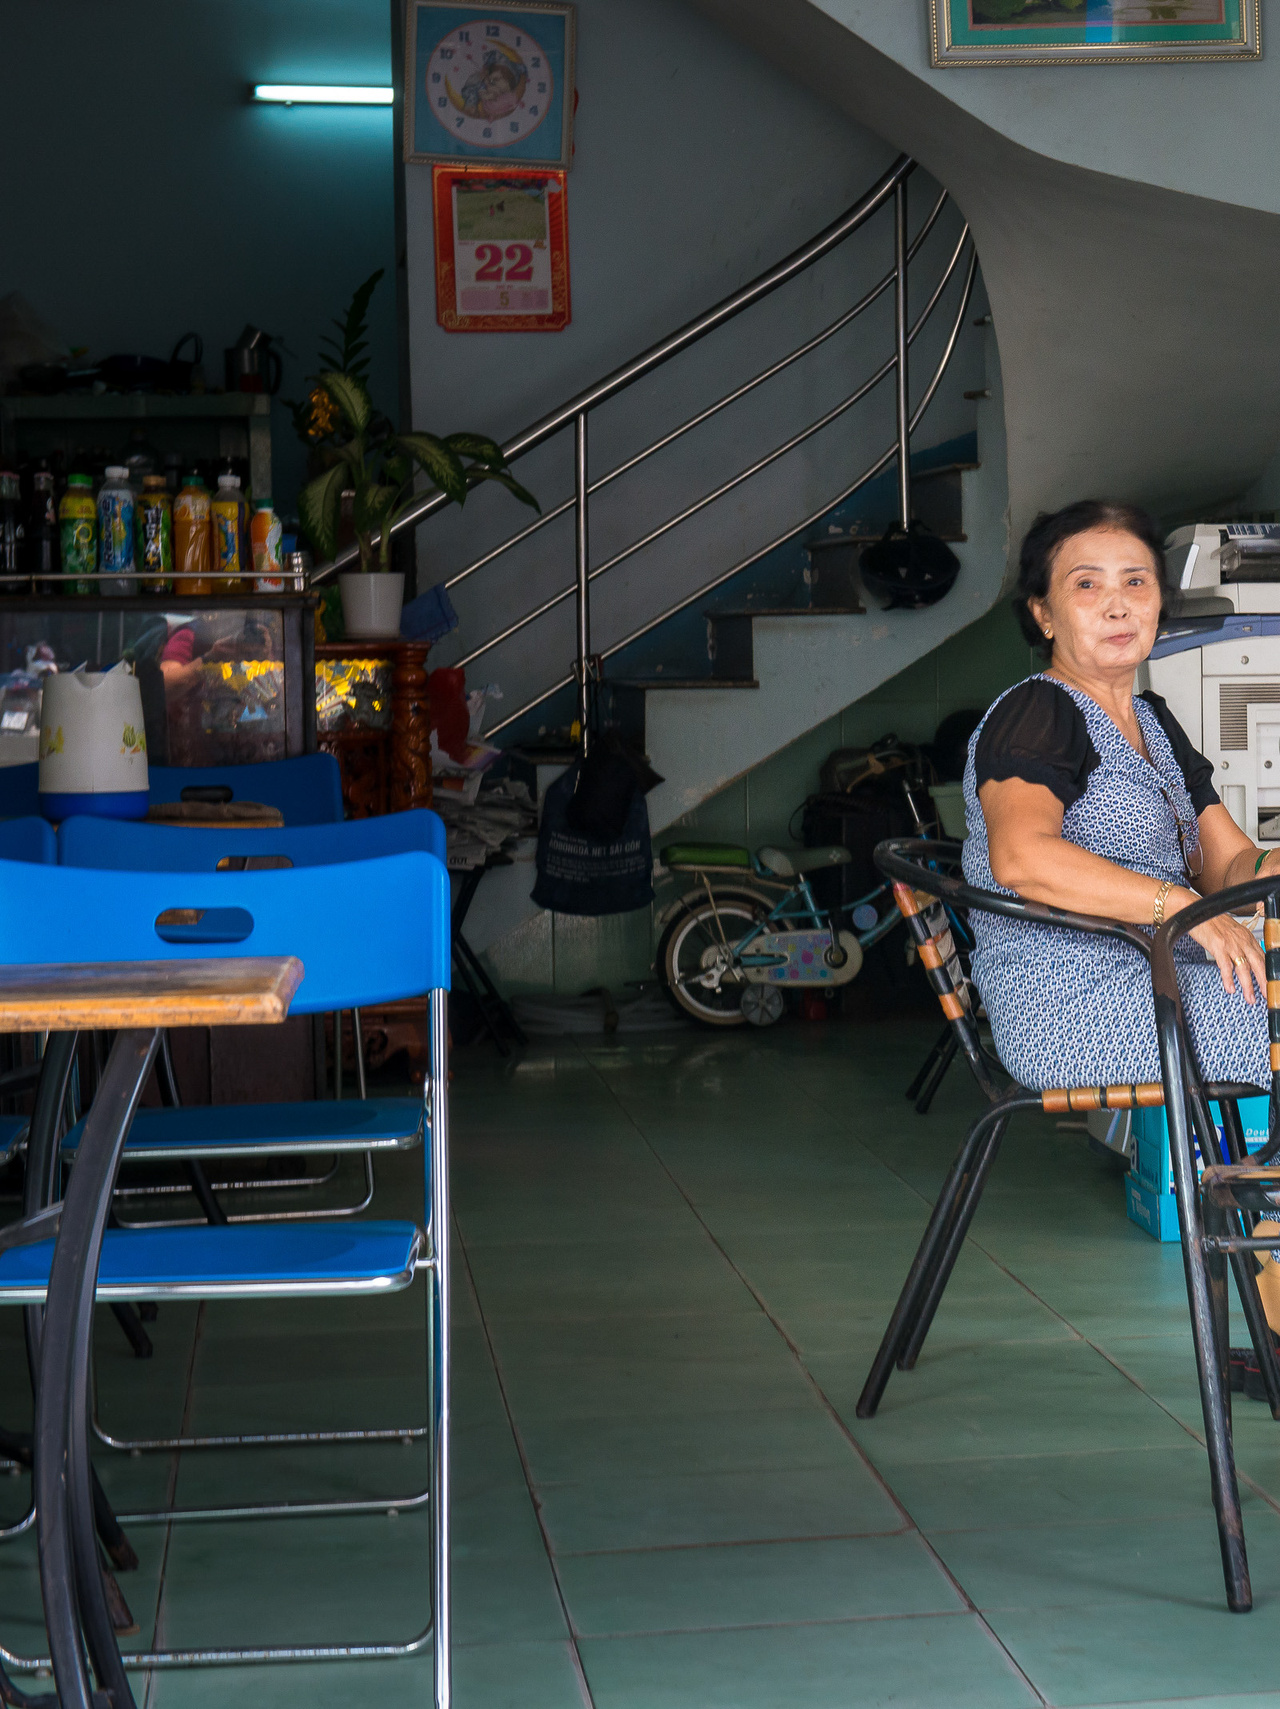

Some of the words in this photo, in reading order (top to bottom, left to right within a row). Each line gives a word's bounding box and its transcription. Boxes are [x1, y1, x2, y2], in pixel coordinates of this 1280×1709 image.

[459, 31, 470, 42] 11
[485, 25, 500, 37] 12
[515, 36, 522, 47] 1
[440, 48, 453, 60] 10
[531, 57, 541, 68] 2
[432, 72, 441, 83] 9
[537, 82, 546, 93] 3
[529, 105, 539, 116] 4
[455, 117, 464, 128] 7
[510, 122, 519, 133] 5
[482, 127, 492, 138] 6
[474, 243, 534, 282] 22
